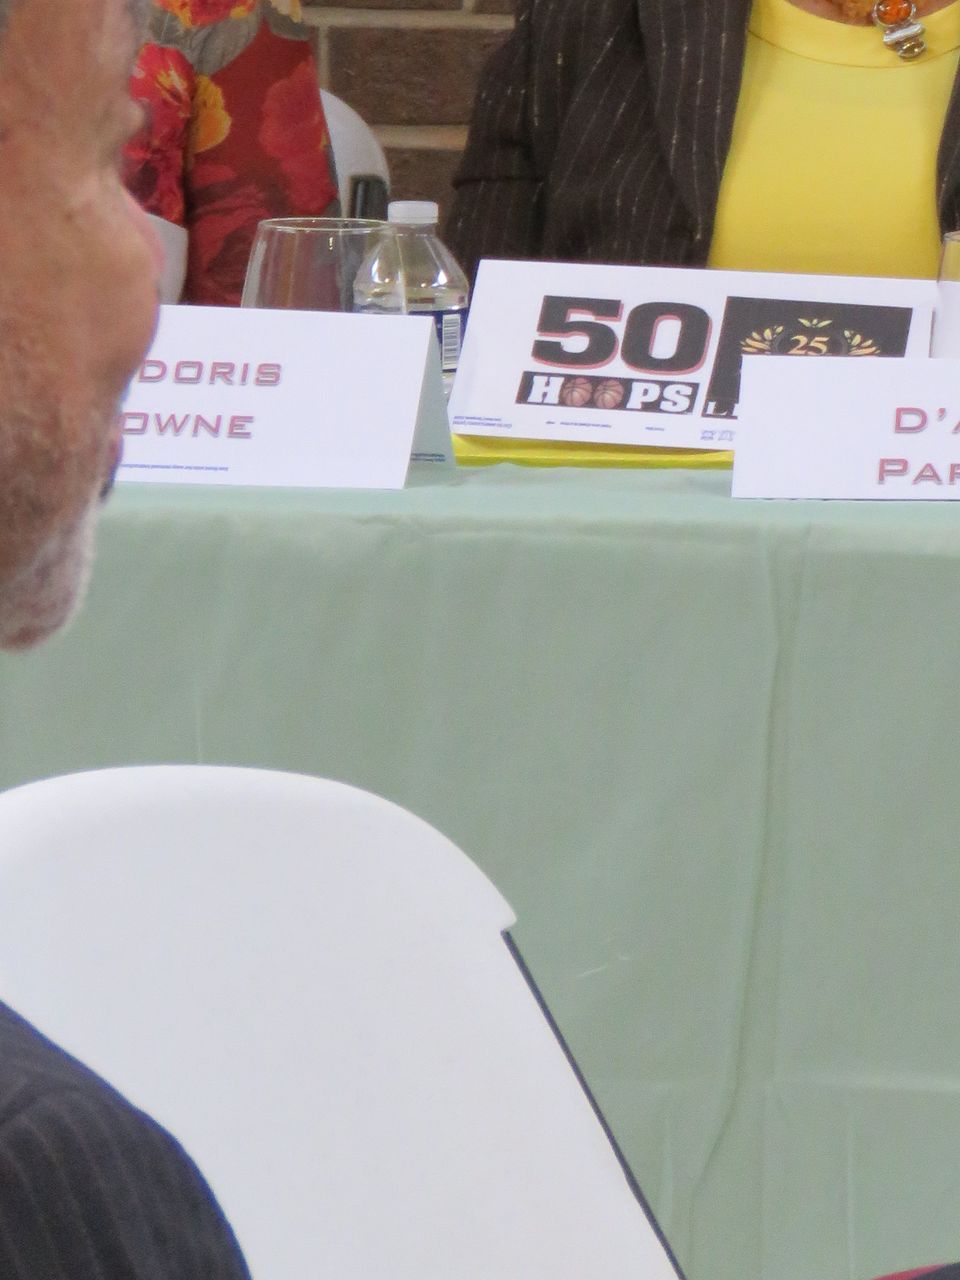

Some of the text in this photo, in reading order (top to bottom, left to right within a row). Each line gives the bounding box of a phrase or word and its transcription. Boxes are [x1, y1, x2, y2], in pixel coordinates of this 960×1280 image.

[531, 295, 712, 376] 50
[788, 335, 831, 355] 25
[137, 359, 282, 387] DORIS
